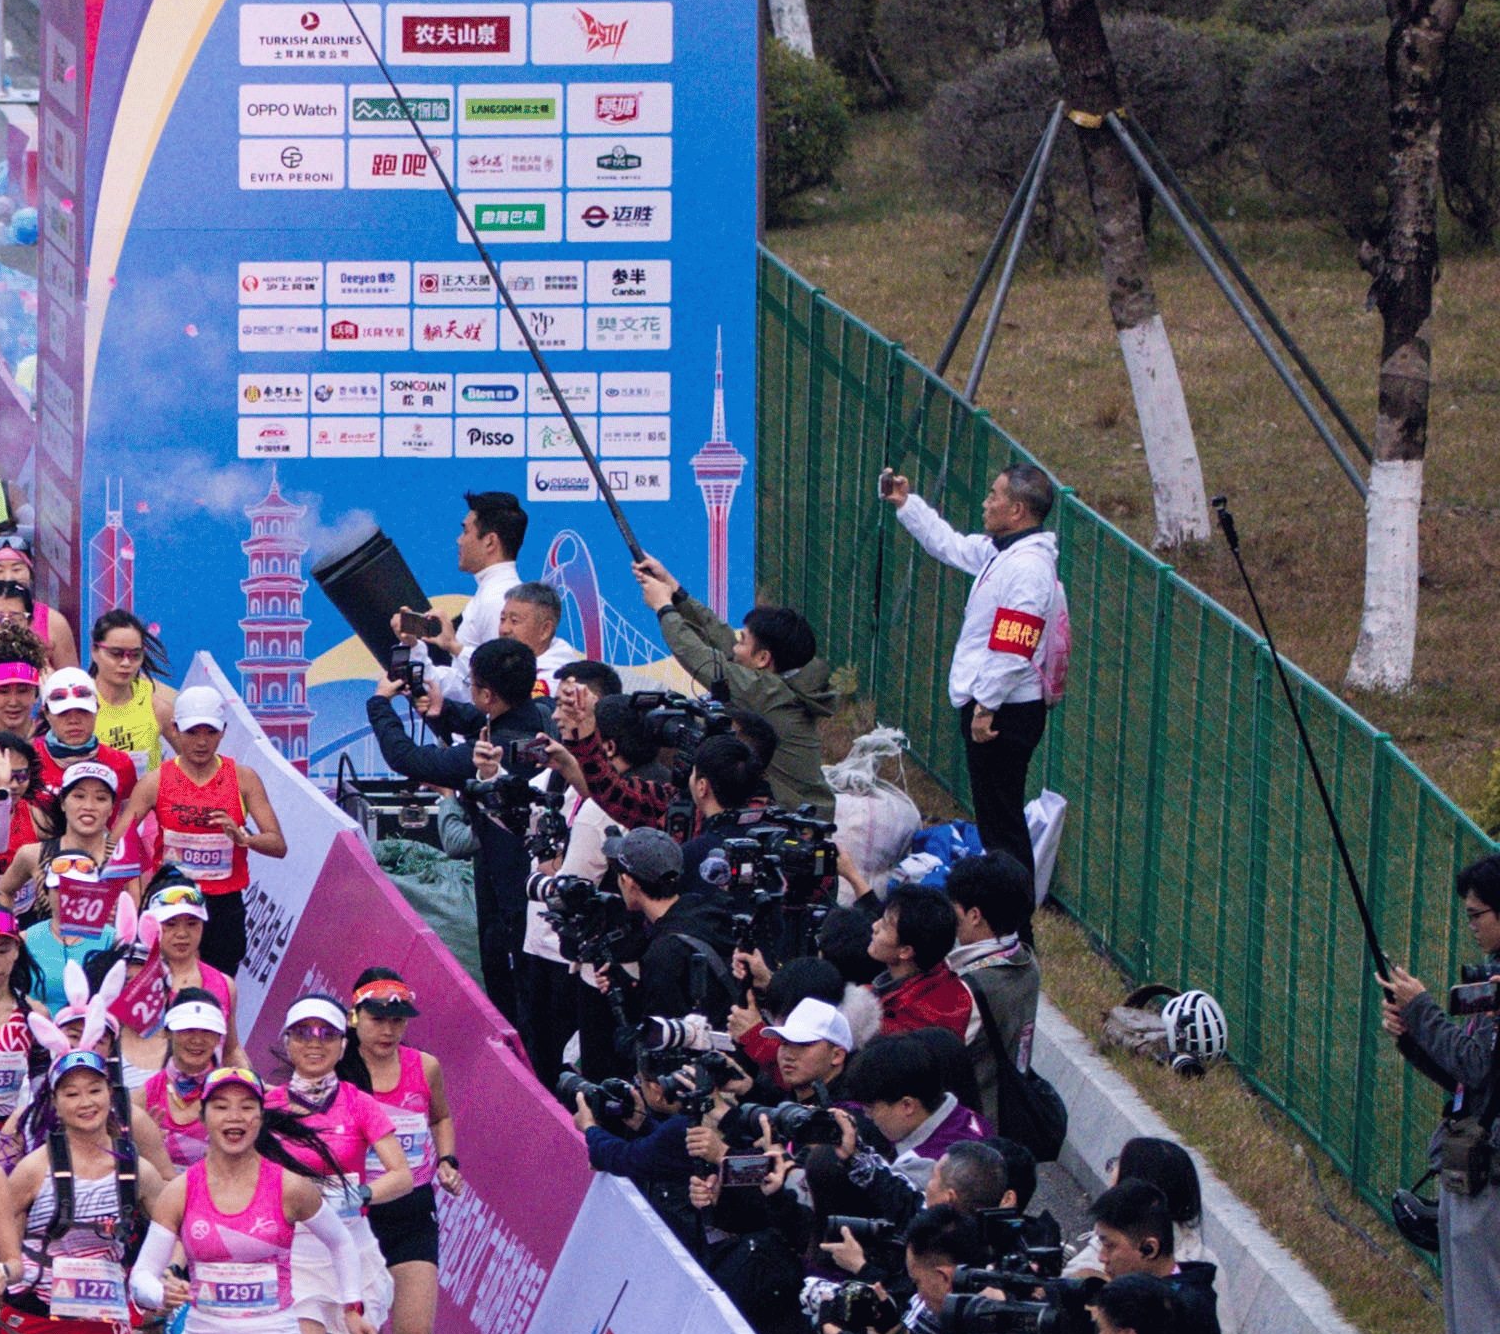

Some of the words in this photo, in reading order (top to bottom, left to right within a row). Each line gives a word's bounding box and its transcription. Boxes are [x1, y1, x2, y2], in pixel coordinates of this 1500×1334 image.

[258, 35, 306, 46] TURKISH
[310, 35, 362, 46] AIRLINES
[414, 23, 497, 47] 农夫山泉
[247, 103, 290, 117] OPPO
[294, 103, 338, 117] Watch
[386, 98, 448, 120] 众安保险
[372, 153, 427, 177] 跑吧
[250, 173, 288, 183] EVITA
[292, 173, 334, 183] PERONI
[612, 205, 653, 222] 迈胜
[441, 274, 491, 288] 正大天晴
[611, 268, 647, 286] 参半
[611, 288, 647, 297] Canban
[596, 316, 661, 335] 樊文花
[389, 381, 446, 392] SONGDIAN
[467, 428, 515, 447] Pisso
[184, 849, 219, 864] 0809
[217, 1282, 260, 1301] 1297
